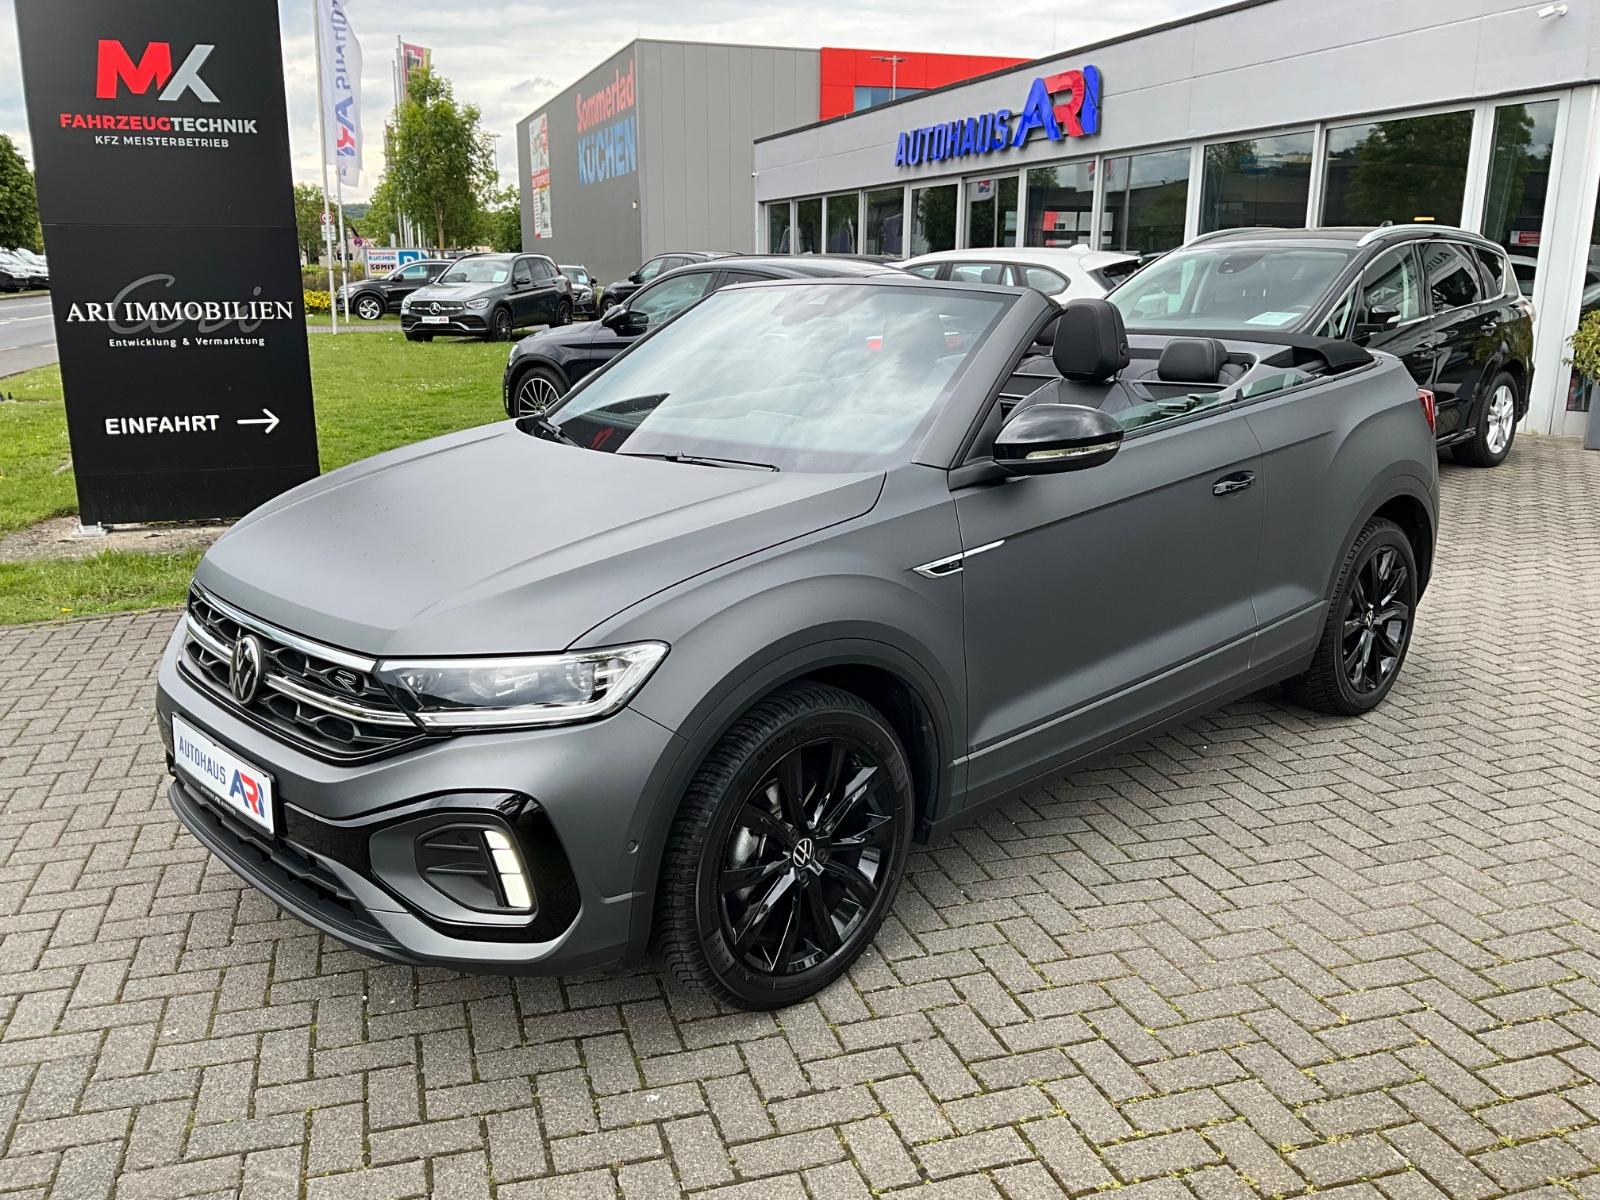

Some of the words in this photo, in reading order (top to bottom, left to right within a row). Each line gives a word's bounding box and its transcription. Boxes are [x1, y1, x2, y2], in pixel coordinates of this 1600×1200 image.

[96, 39, 220, 103] MK
[576, 60, 635, 133] Sommerlad
[895, 109, 1011, 167] AUTOHAUS
[1012, 64, 1100, 147] ARI
[60, 113, 258, 134] FAHRZEUGTECHNIK
[95, 135, 119, 146] KFZ
[123, 136, 229, 148] MEISTERBETRIEB
[578, 116, 637, 185] KÜCHEN
[66, 302, 116, 322] ARI
[124, 301, 294, 321] IMMOBILIEN
[109, 337, 177, 348] Entwicklung
[182, 338, 190, 346] &
[195, 336, 265, 347] Vermarktung
[105, 414, 220, 435] EINFAHRT
[179, 735, 226, 785] AUTOHAUS
[229, 768, 264, 818] ARI
